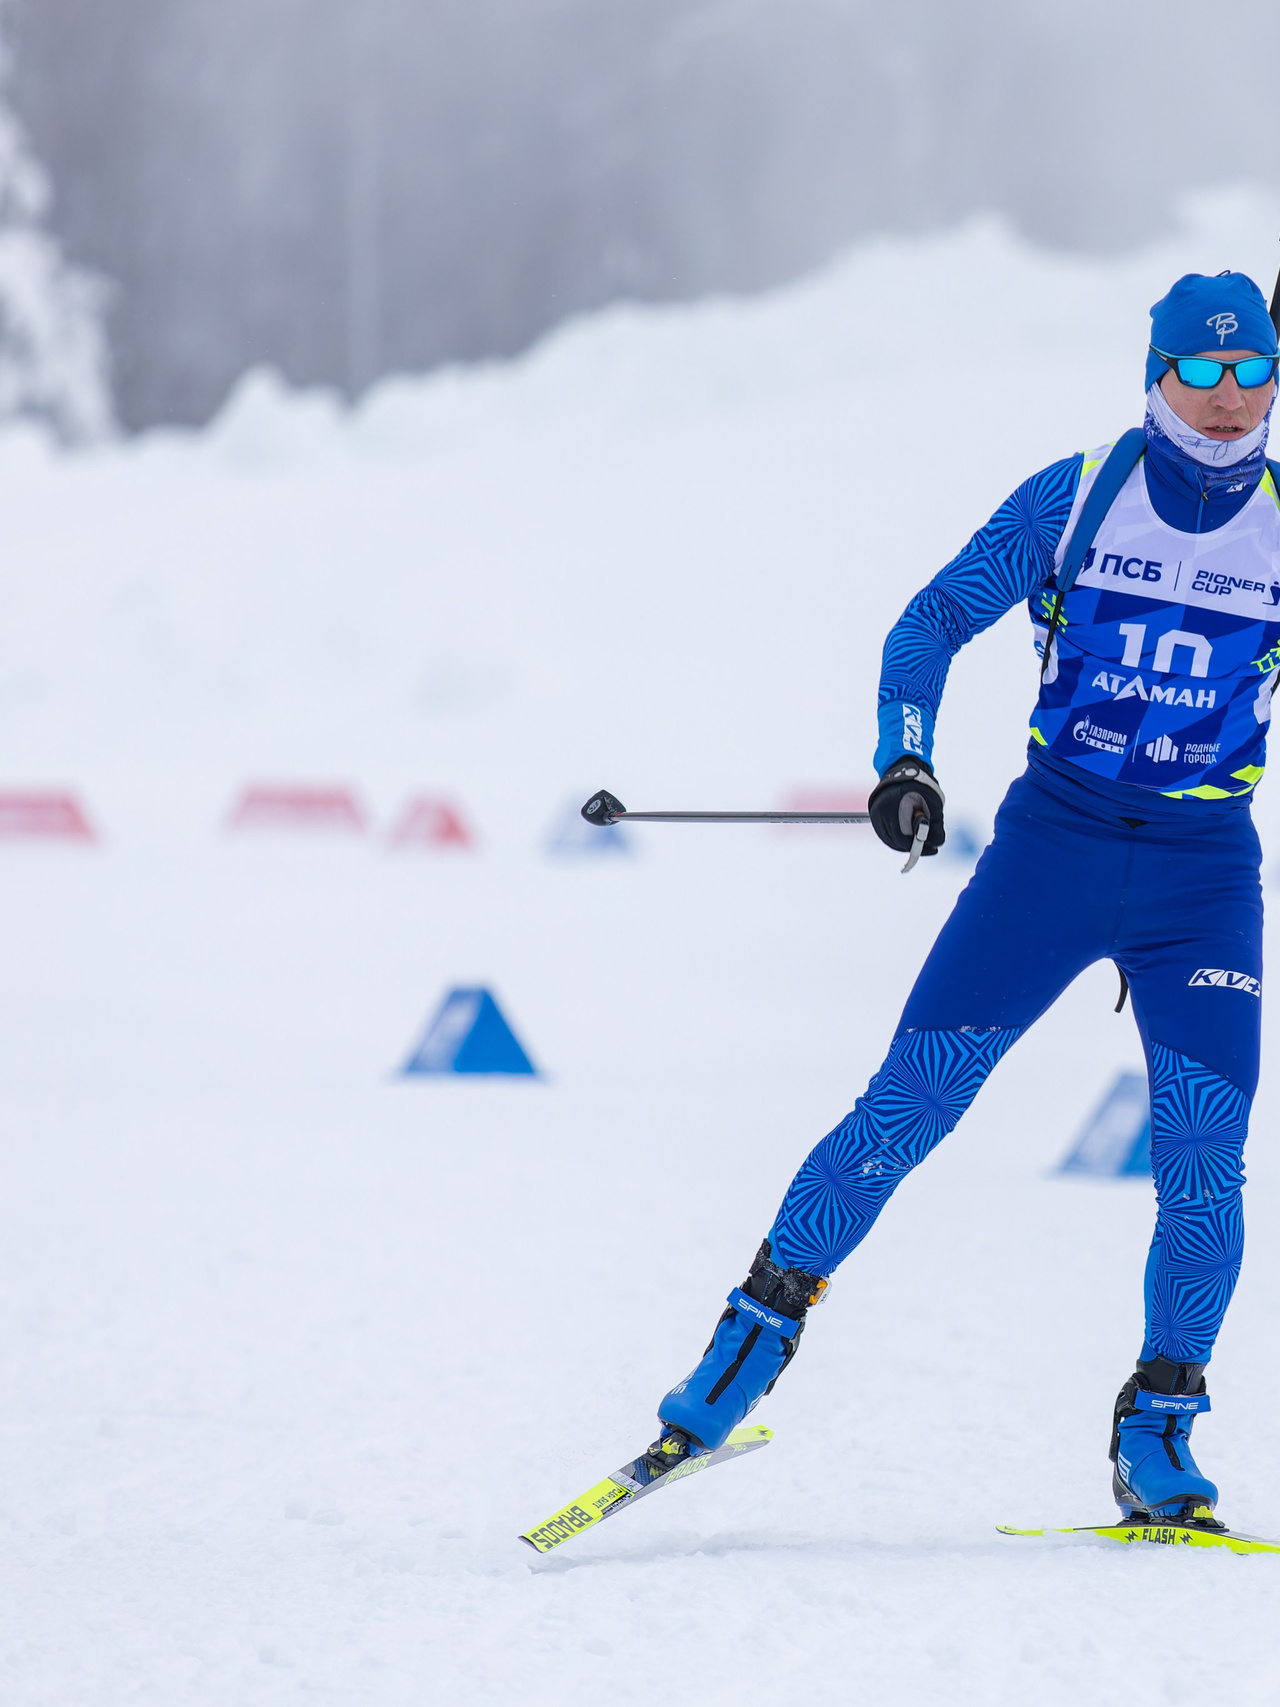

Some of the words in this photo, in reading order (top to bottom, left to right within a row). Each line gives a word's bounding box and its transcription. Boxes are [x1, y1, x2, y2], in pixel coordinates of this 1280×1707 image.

[1099, 553, 1162, 582] ПСБ
[1191, 580, 1232, 596] CUP
[1195, 569, 1266, 593] PIONER
[1118, 623, 1213, 678] 10
[1092, 671, 1216, 709] АТАМАН
[1089, 724, 1127, 746] ГАЗПРОМ
[1183, 753, 1217, 765] ГОРОДА
[1185, 743, 1221, 754] РОДНЫЕ
[737, 1298, 783, 1328] SPINE
[1151, 1399, 1199, 1410] SPINE
[530, 1505, 594, 1549] BRADOS
[1142, 1528, 1176, 1545] FLASH
